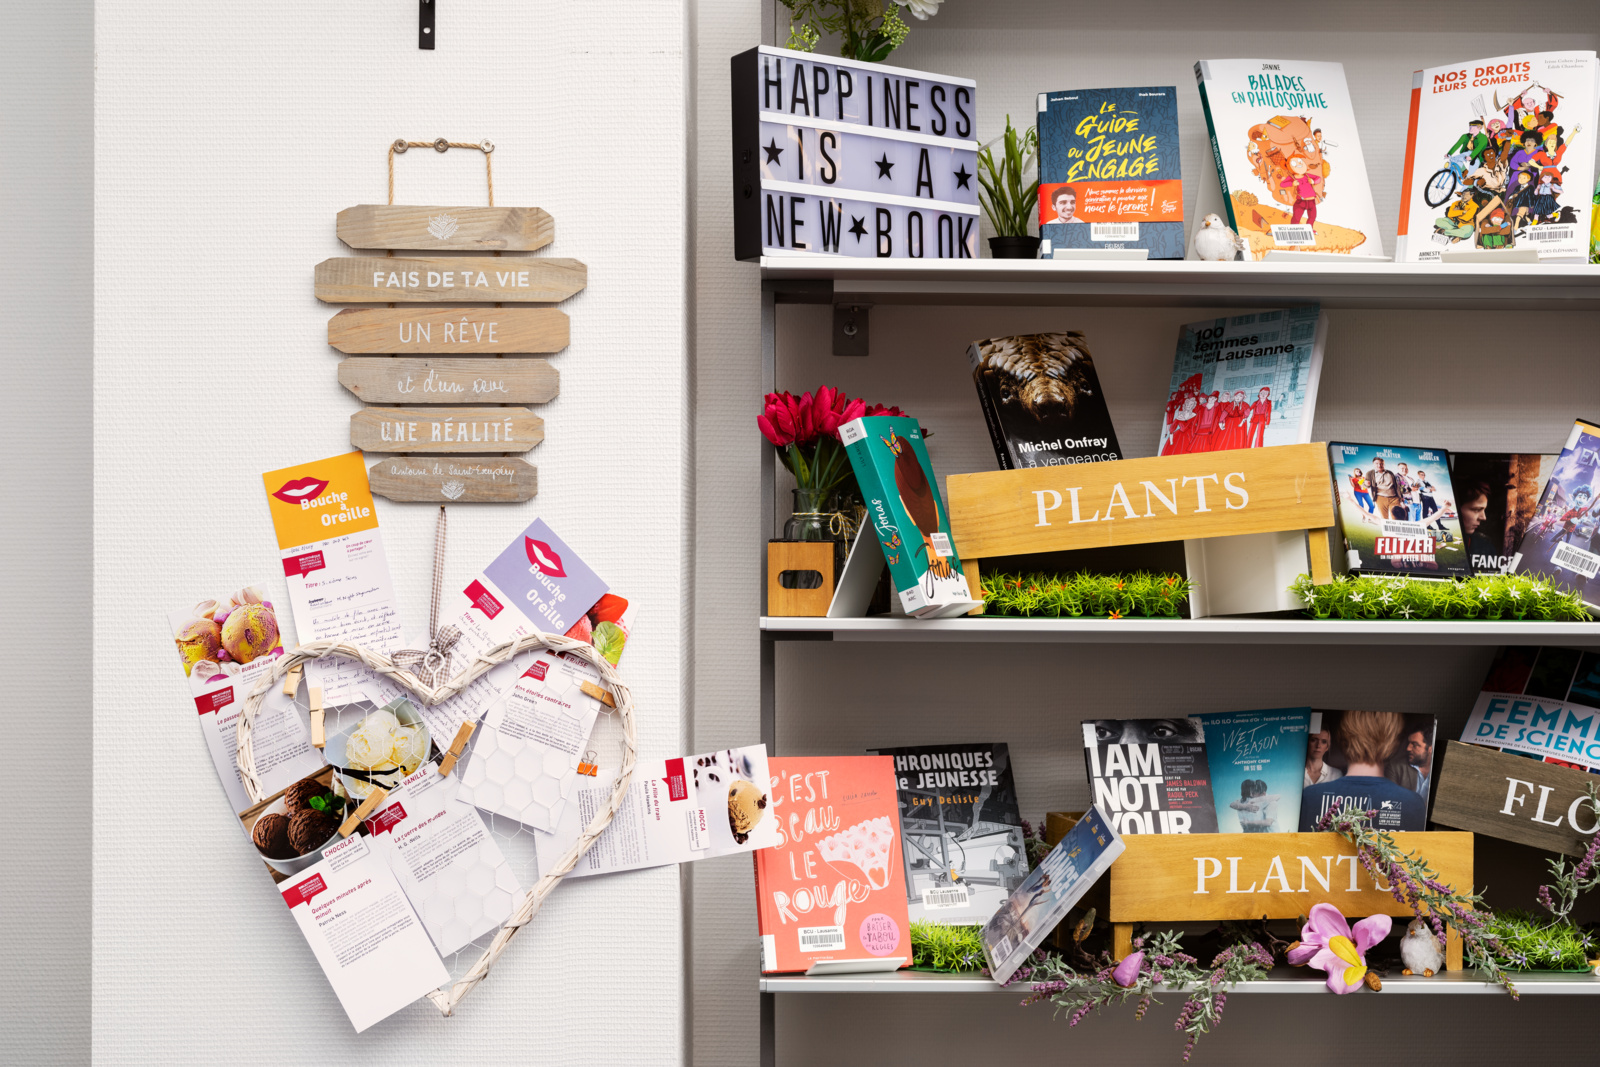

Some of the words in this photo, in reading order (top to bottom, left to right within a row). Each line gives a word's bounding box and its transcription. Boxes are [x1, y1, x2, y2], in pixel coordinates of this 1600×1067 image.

[1248, 74, 1306, 92] BALADES
[1432, 80, 1467, 94] LEURS
[1472, 73, 1530, 88] COMBATS
[1434, 70, 1468, 84] NOS
[1474, 62, 1531, 78] DROITS
[764, 56, 971, 138] HAPPINESS
[1232, 92, 1246, 104] EN
[1247, 91, 1328, 110] PHILOSOPHIE
[1100, 102, 1116, 114] LE
[1076, 114, 1140, 138] GUIDE
[1068, 148, 1084, 158] DU
[1086, 134, 1158, 162] JEUNE
[798, 128, 836, 184] IS
[916, 148, 934, 198] A
[1067, 154, 1160, 183] ENGAGÉ
[1084, 204, 1106, 214] nous
[1108, 202, 1116, 213] le
[1118, 202, 1148, 216] ferons
[766, 194, 842, 253] NEW
[876, 208, 973, 258] BOOK
[373, 271, 420, 288] FAIS
[427, 271, 454, 288] DE
[461, 271, 488, 288] TA
[496, 271, 529, 288] VIE
[400, 322, 430, 342] UN
[444, 317, 499, 342] RÊVE
[1195, 326, 1224, 341] 100
[1194, 336, 1258, 353] femmes
[1216, 343, 1295, 362] Lausanne
[398, 374, 415, 393] et
[424, 370, 464, 392] d'un
[381, 422, 418, 441] UNE
[431, 417, 514, 441] RÉALITÉ
[1018, 438, 1062, 455] Michel
[1064, 436, 1108, 452] Onfray
[391, 465, 428, 475] Antoine
[433, 465, 443, 476] de
[300, 492, 348, 511] Bouche
[340, 501, 347, 511] à
[1032, 472, 1250, 527] PLANTS
[321, 506, 370, 526] Oreille
[874, 498, 899, 536] Jonas
[1377, 538, 1433, 554] FLITZER
[528, 562, 566, 602] Bouche
[526, 589, 565, 630] Oreille
[240, 657, 274, 672] BUBBLE-GUM
[1222, 723, 1268, 752] WET
[1476, 722, 1510, 740] DE
[1105, 743, 1162, 777] AM
[1232, 735, 1279, 764] SEASON
[402, 768, 428, 786] VANILLE
[916, 771, 999, 789] JEUNESSE
[770, 770, 830, 807] C'EST
[1094, 776, 1164, 812] NOT
[912, 797, 933, 807] Guy
[939, 795, 980, 804] Delisle
[697, 809, 706, 831] MOCCA
[1110, 810, 1192, 834] YOUR
[322, 836, 356, 857] CHOCOLAT
[393, 835, 401, 843] La
[790, 851, 818, 880] LE
[1040, 842, 1079, 900] DANCE
[310, 897, 336, 915] Quelques
[334, 886, 357, 901] minutes
[355, 877, 372, 889] après
[774, 879, 870, 926] Rouge
[313, 907, 332, 920] minuit
[317, 915, 335, 927] Patrick
[334, 908, 347, 918] Ness
[867, 922, 892, 932] BRISER
[868, 932, 896, 942] TABOU
